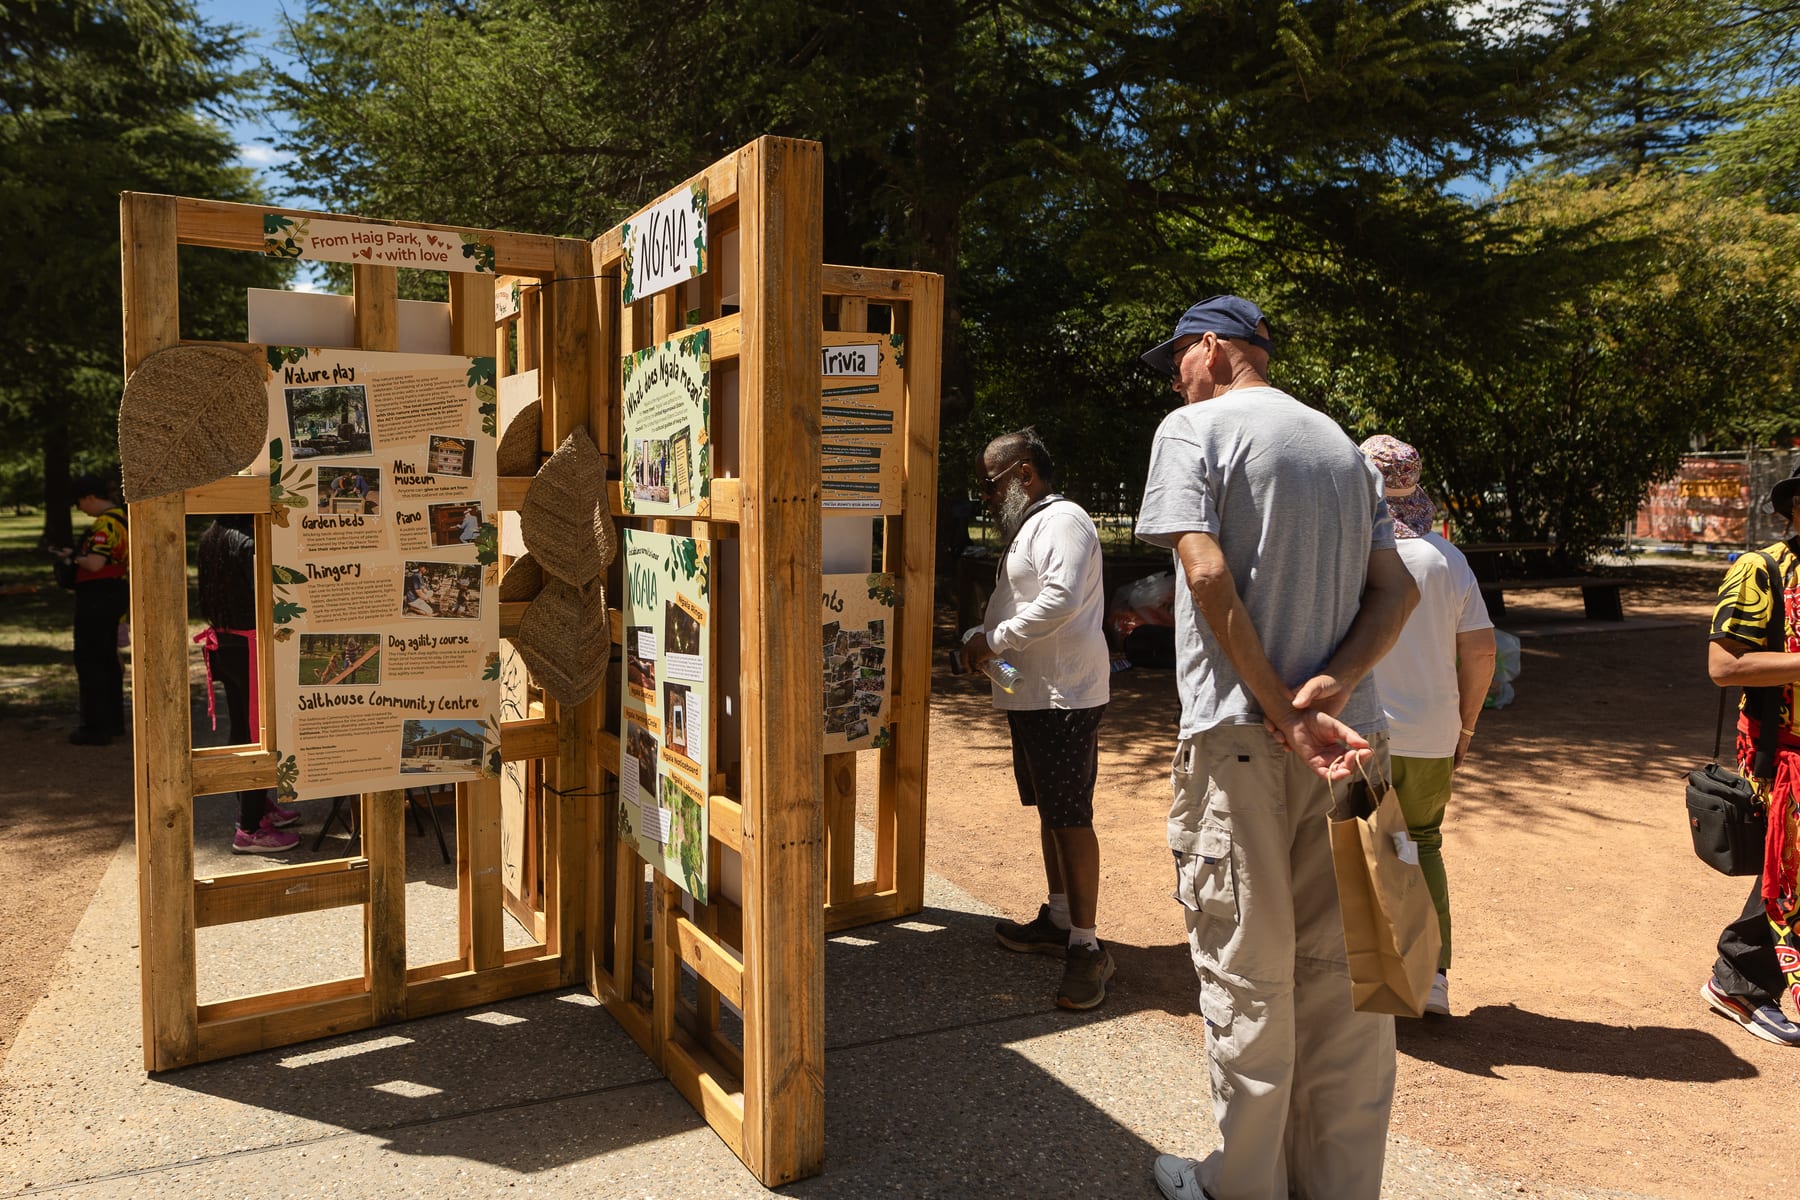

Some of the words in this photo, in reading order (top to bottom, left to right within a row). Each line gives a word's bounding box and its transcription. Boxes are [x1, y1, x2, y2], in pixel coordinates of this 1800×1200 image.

[311, 235, 349, 249] From
[351, 230, 384, 246] Haig
[387, 231, 422, 247] Park,
[385, 248, 417, 261] with
[420, 248, 449, 262] love
[639, 209, 688, 293] NGALA
[822, 348, 866, 375] Trivia
[284, 366, 330, 385] Nature
[333, 362, 355, 384] play
[625, 379, 644, 419] What
[644, 368, 658, 394] does
[659, 353, 680, 388] Ngala
[679, 366, 703, 408] mean?
[393, 459, 416, 475] Mini
[394, 475, 436, 486] museum
[301, 514, 337, 530] Garden
[338, 512, 365, 527] beds
[395, 511, 422, 526] Piano
[305, 562, 362, 582] Thingery
[627, 562, 658, 611] NGALA
[388, 634, 406, 652] Dog
[407, 632, 438, 651] agility
[439, 635, 470, 645] course
[297, 691, 365, 711] Salthouse
[368, 690, 435, 714] Community
[438, 694, 480, 710] Centre
